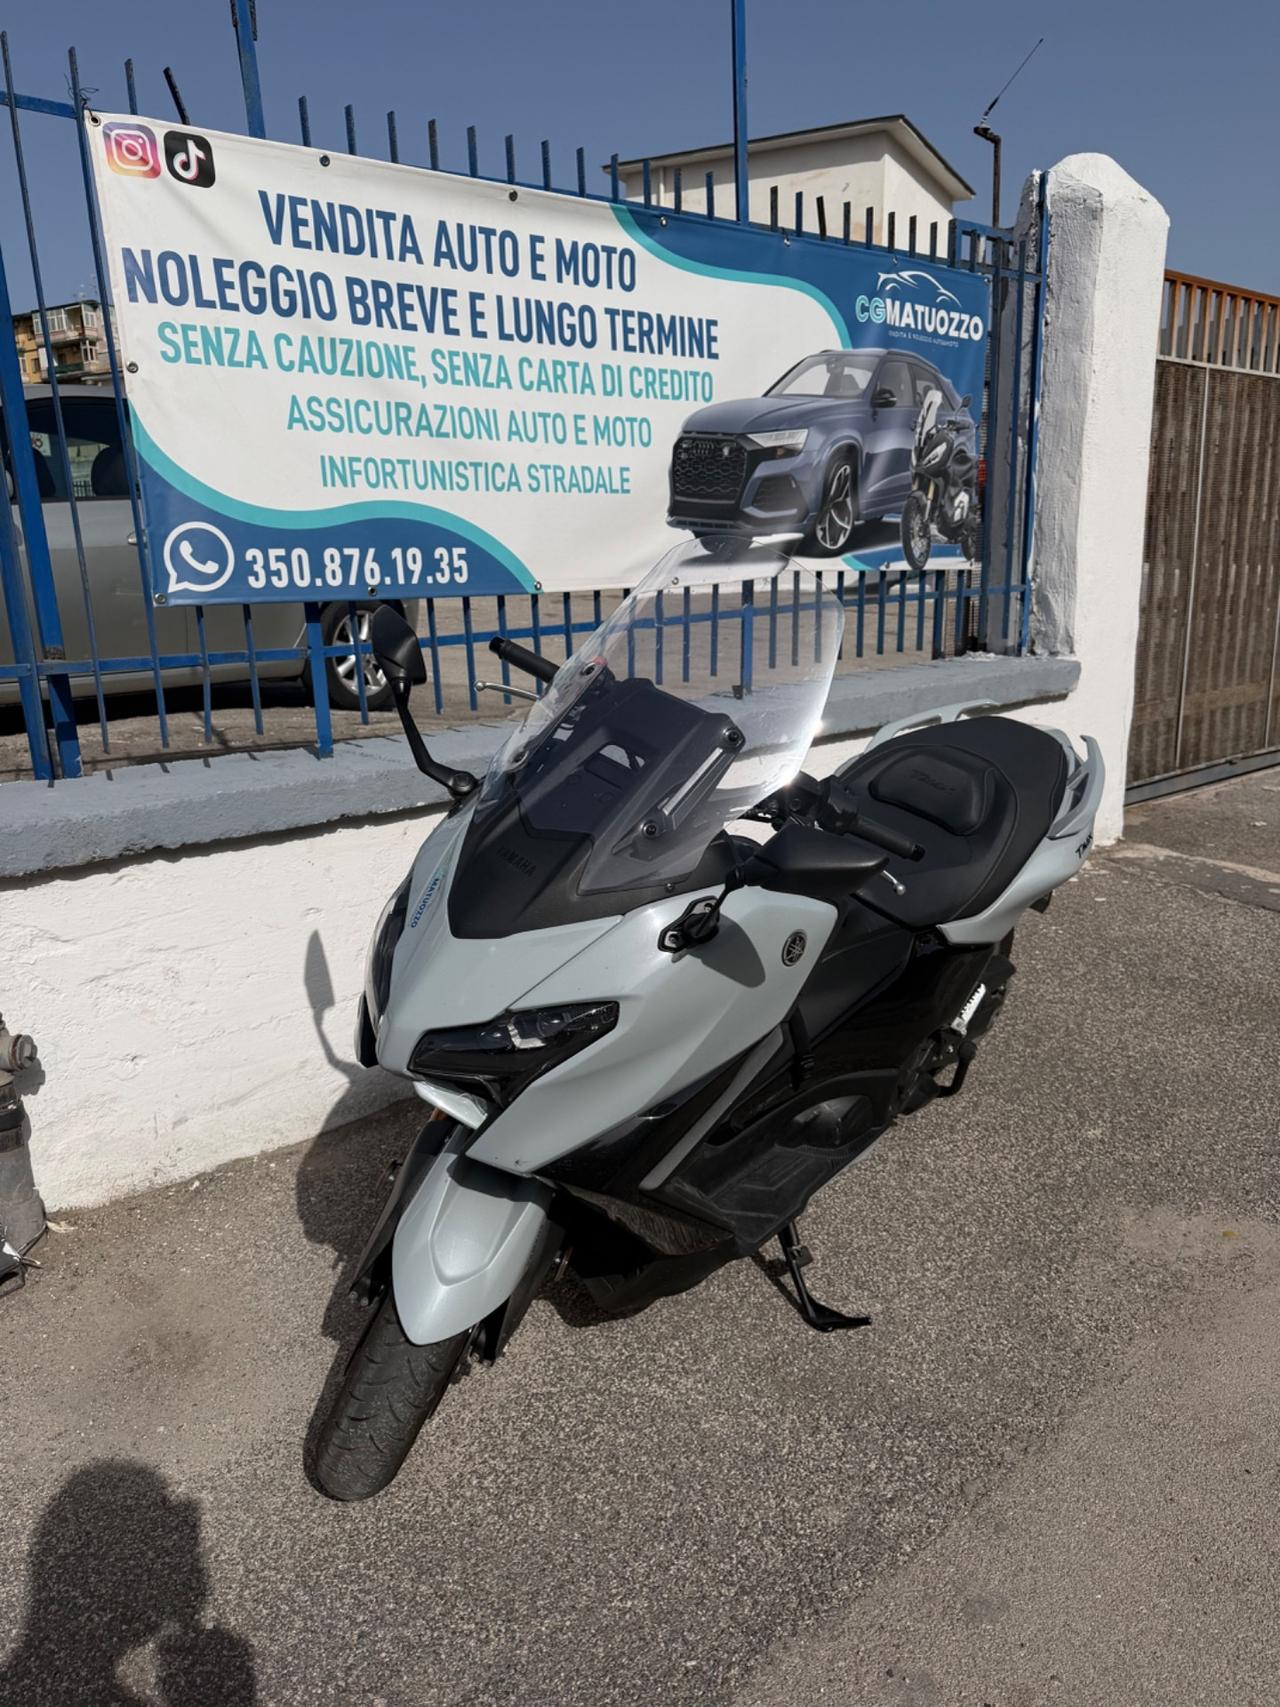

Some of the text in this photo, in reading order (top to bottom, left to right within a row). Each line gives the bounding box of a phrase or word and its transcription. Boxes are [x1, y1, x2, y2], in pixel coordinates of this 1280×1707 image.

[258, 189, 637, 293] VENDITA AUTO E MOTO
[121, 247, 720, 360] NOLEGGIO BREVE E LUNGO TERMINE
[855, 294, 983, 342] CGMATUOZZO
[157, 321, 713, 403] SENZA CAUZIONE, SENZA CARTA DI CREDITO
[287, 394, 652, 448] ASSICURAZIONI AUTO E MOTO
[320, 455, 632, 494] INFORTUNISTICA STRADALE
[244, 547, 470, 589] 350.876.19.35
